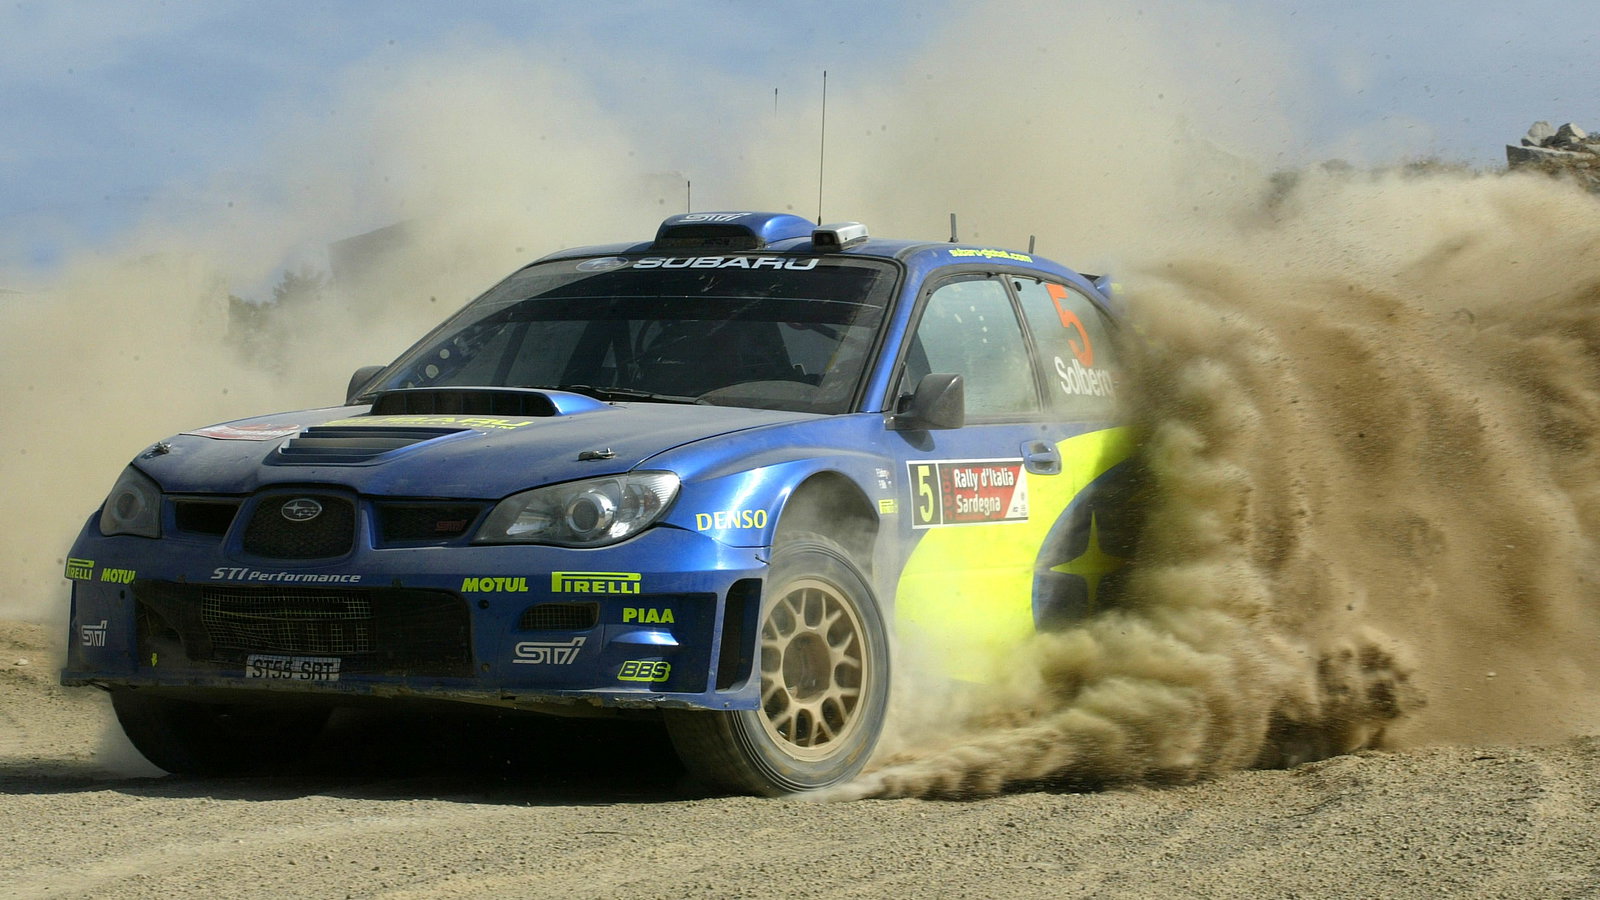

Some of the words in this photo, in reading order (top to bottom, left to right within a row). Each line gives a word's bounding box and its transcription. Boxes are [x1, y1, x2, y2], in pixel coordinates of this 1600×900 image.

[633, 256, 820, 271] SUBARU
[1045, 283, 1094, 368] 5
[953, 468, 978, 491] Rally
[980, 467, 1014, 487] d'Italia
[917, 465, 934, 522] 5
[956, 494, 1001, 516] Sardegna
[695, 509, 768, 531] DENSO
[210, 567, 248, 580] STI
[248, 570, 361, 583] Performance
[460, 576, 529, 593] MOTUL
[551, 571, 642, 594] PIRELLI
[622, 607, 675, 624] PIAA
[251, 659, 293, 680] ST55
[300, 660, 334, 681] SRT
[617, 659, 672, 683] BBS
